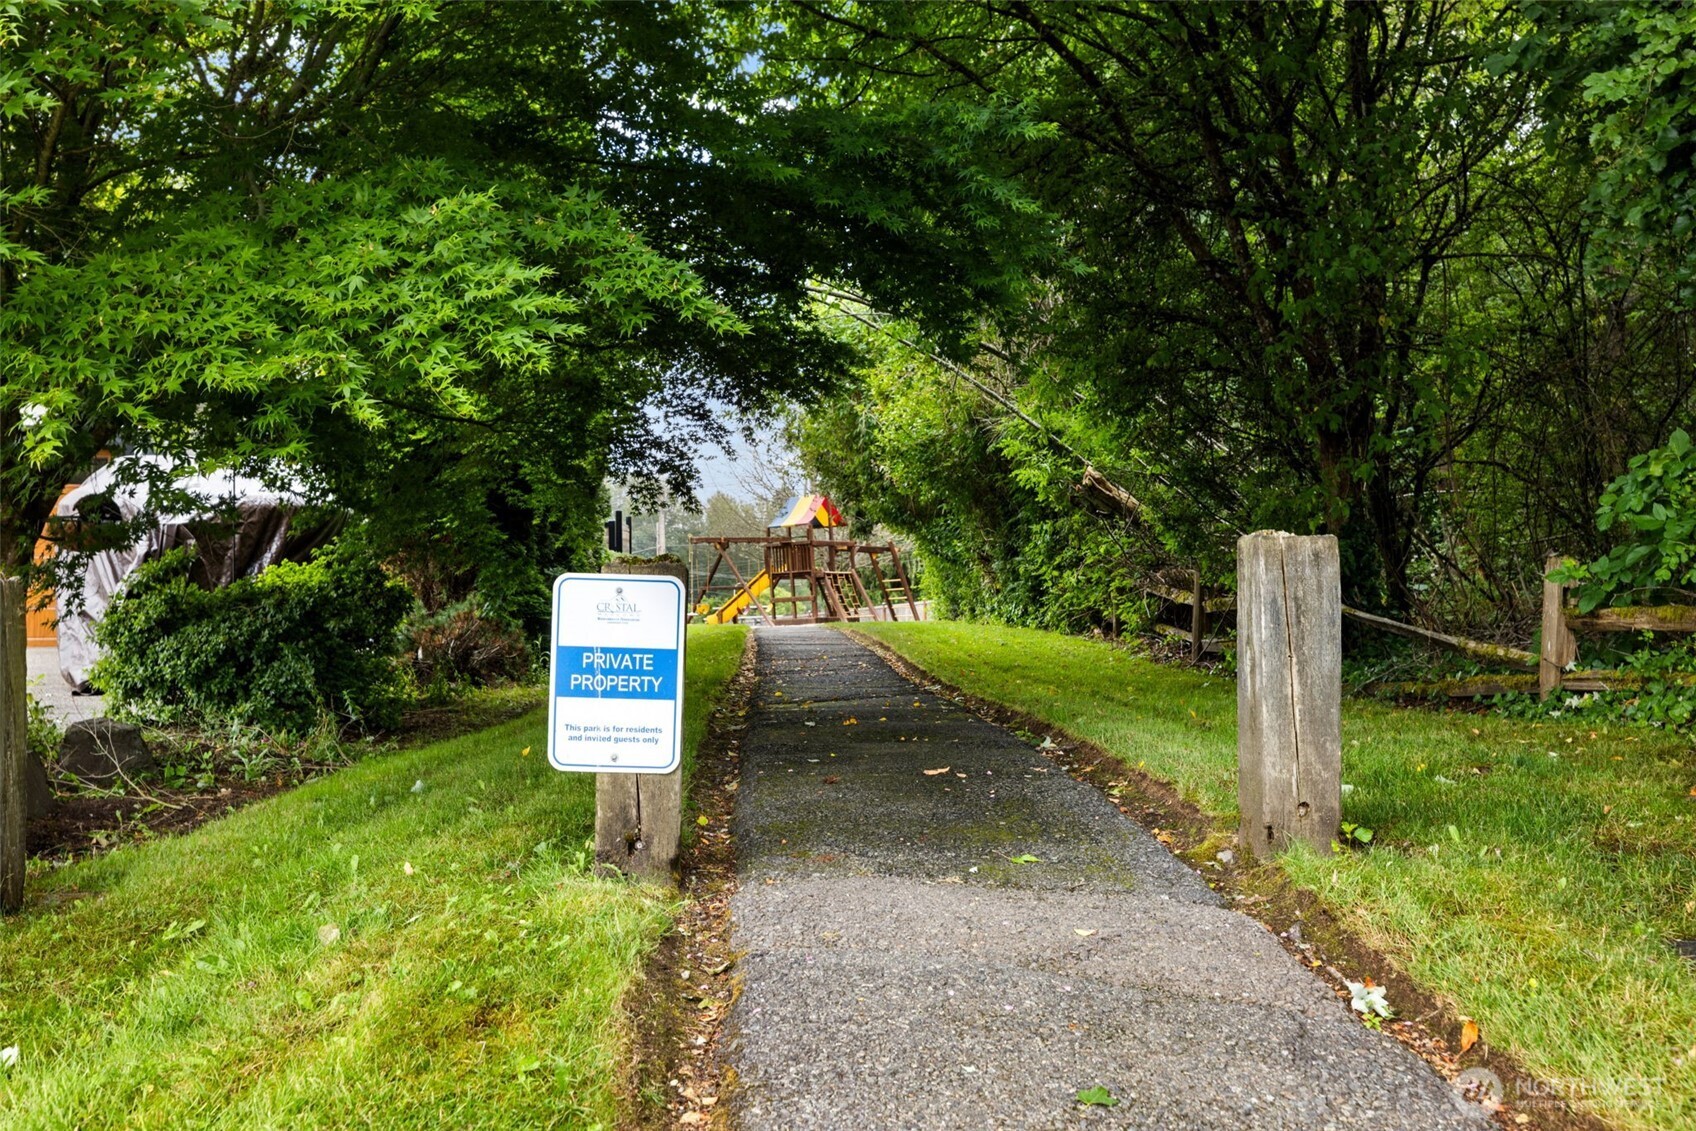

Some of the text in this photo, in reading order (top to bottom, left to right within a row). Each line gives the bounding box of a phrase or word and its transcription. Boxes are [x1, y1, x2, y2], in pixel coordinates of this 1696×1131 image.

[597, 602, 639, 613] CRSTAL
[582, 652, 654, 670] PRIVATE
[570, 674, 663, 692] PROPERTY
[565, 724, 581, 732] This
[583, 724, 600, 735] park
[626, 726, 663, 734] residents
[614, 736, 640, 744] guests
[642, 736, 659, 745] only
